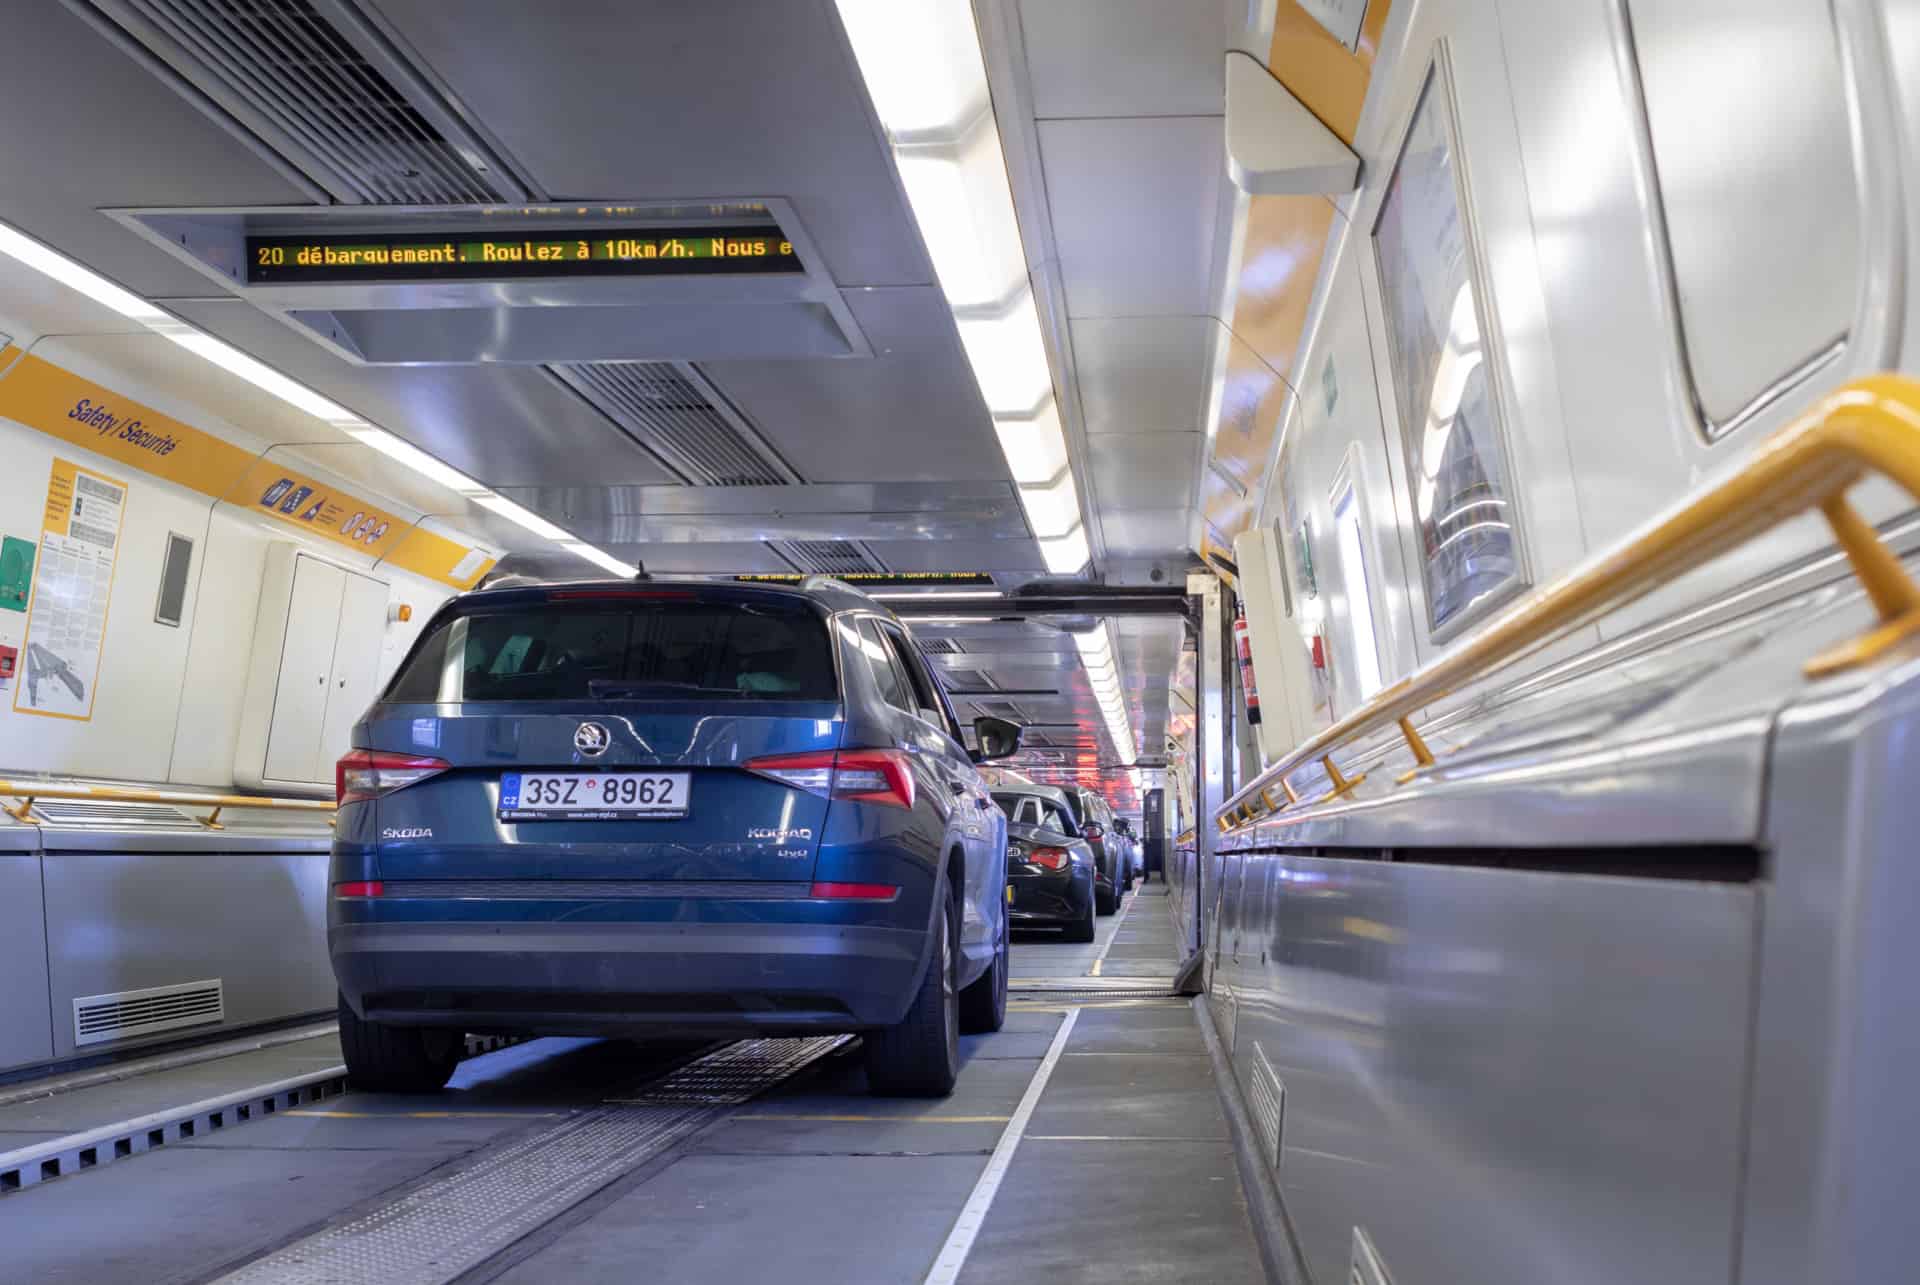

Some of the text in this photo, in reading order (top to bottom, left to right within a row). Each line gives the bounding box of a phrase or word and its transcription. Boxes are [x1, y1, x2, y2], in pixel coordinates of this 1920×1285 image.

[259, 247, 284, 265] 20
[483, 242, 563, 261] Roulez
[577, 241, 590, 260] à
[605, 240, 695, 260] 10km/h.
[712, 238, 767, 257] Nous
[503, 796, 518, 806] CZ
[527, 778, 674, 805] 3SZ 8962
